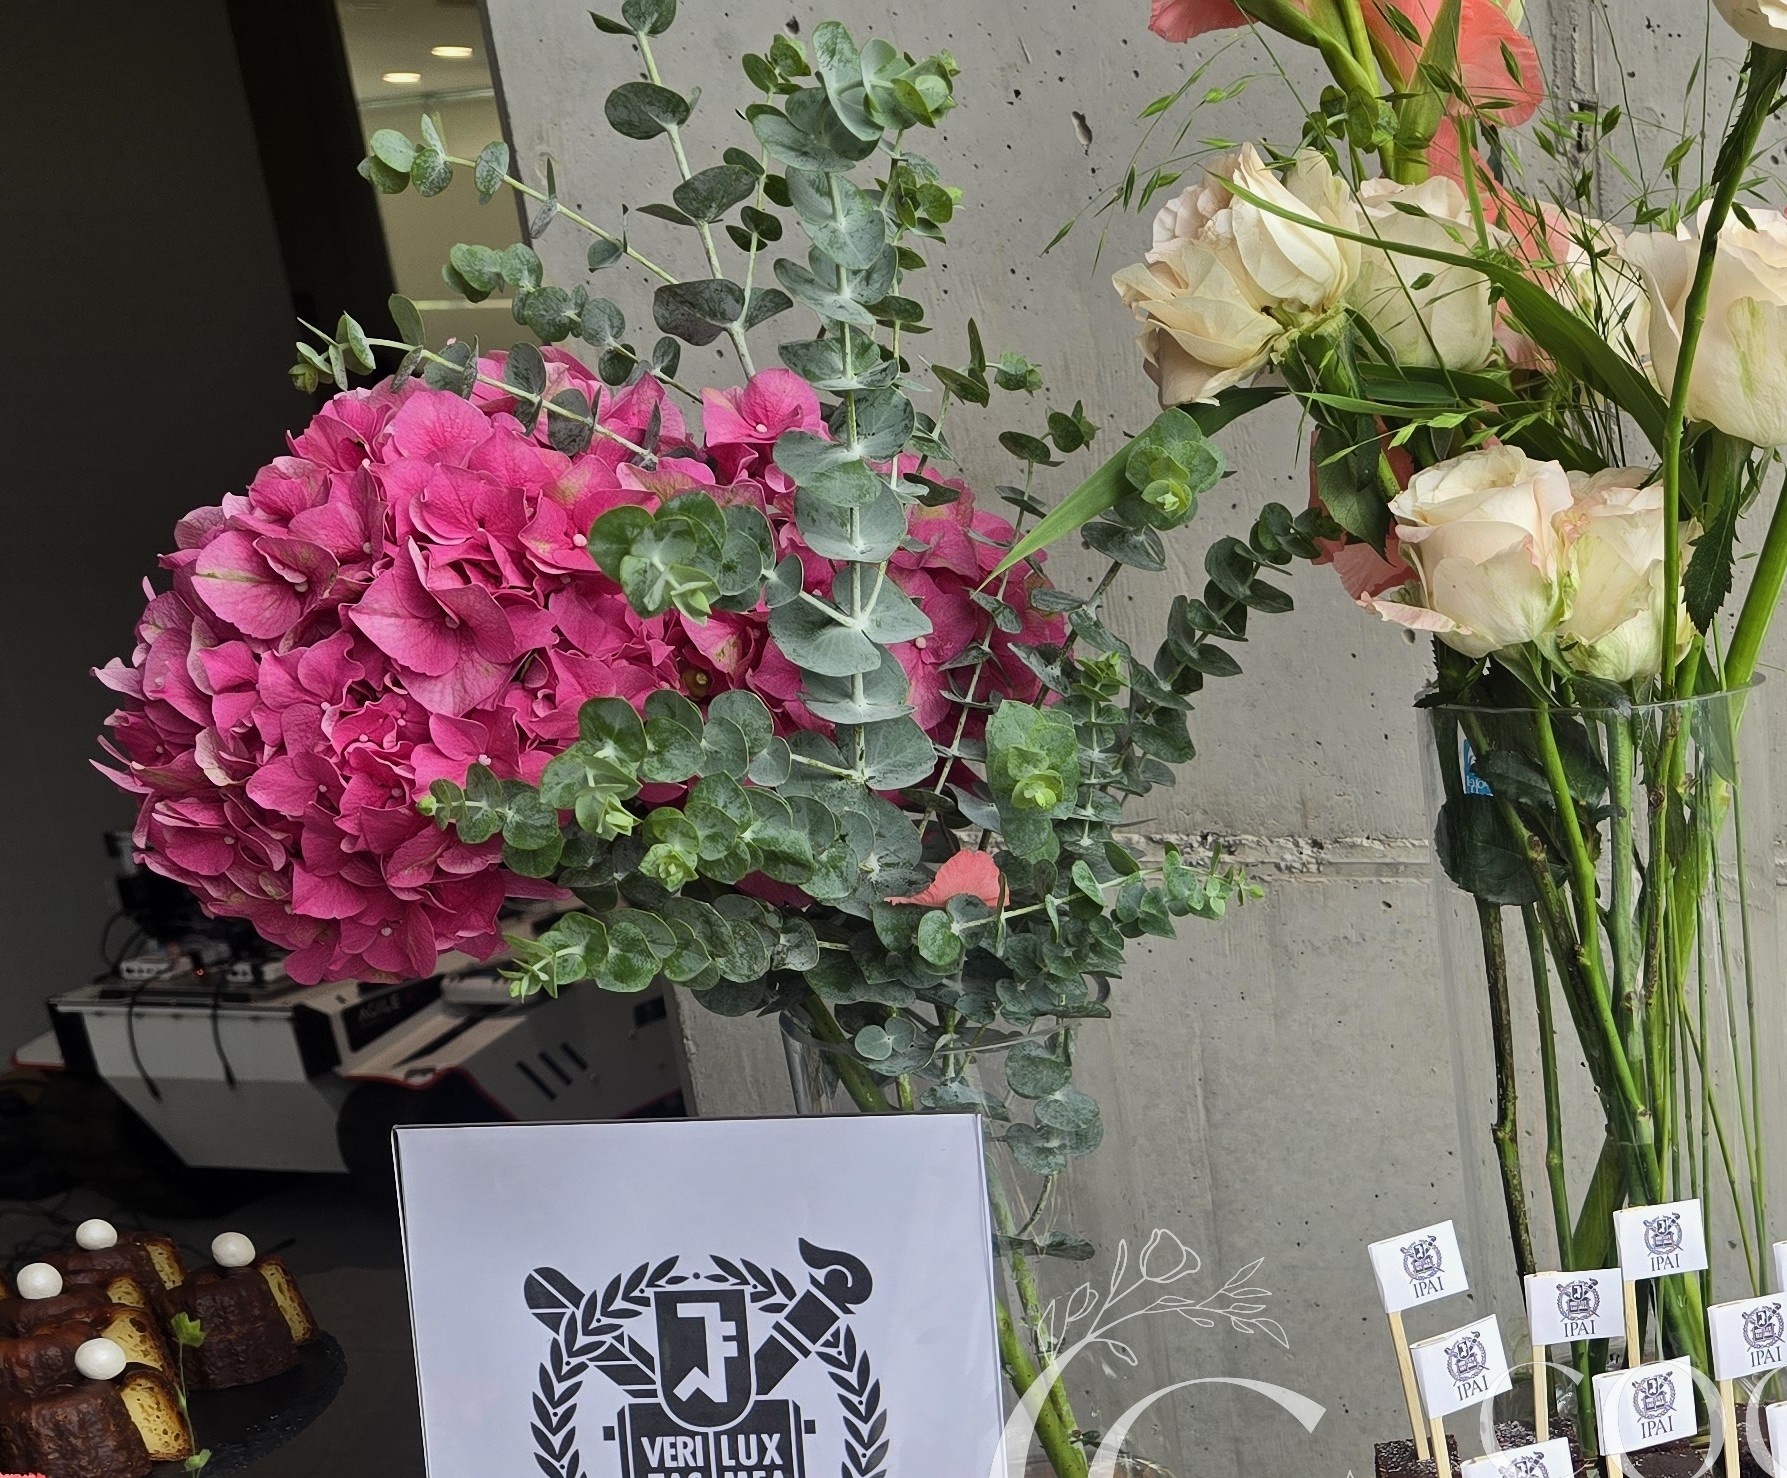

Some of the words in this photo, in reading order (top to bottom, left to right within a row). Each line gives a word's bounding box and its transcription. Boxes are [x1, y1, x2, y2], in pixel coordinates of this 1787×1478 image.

[1651, 1254, 1679, 1271] IPAI
[1414, 1277, 1444, 1297] IPAI
[1564, 1319, 1595, 1337] IPAI
[1750, 1346, 1781, 1366] IPAI
[1458, 1376, 1488, 1399] IPAI
[1640, 1416, 1673, 1439] IPAI
[641, 1435, 704, 1468] VERI
[721, 1433, 782, 1465] LUX
